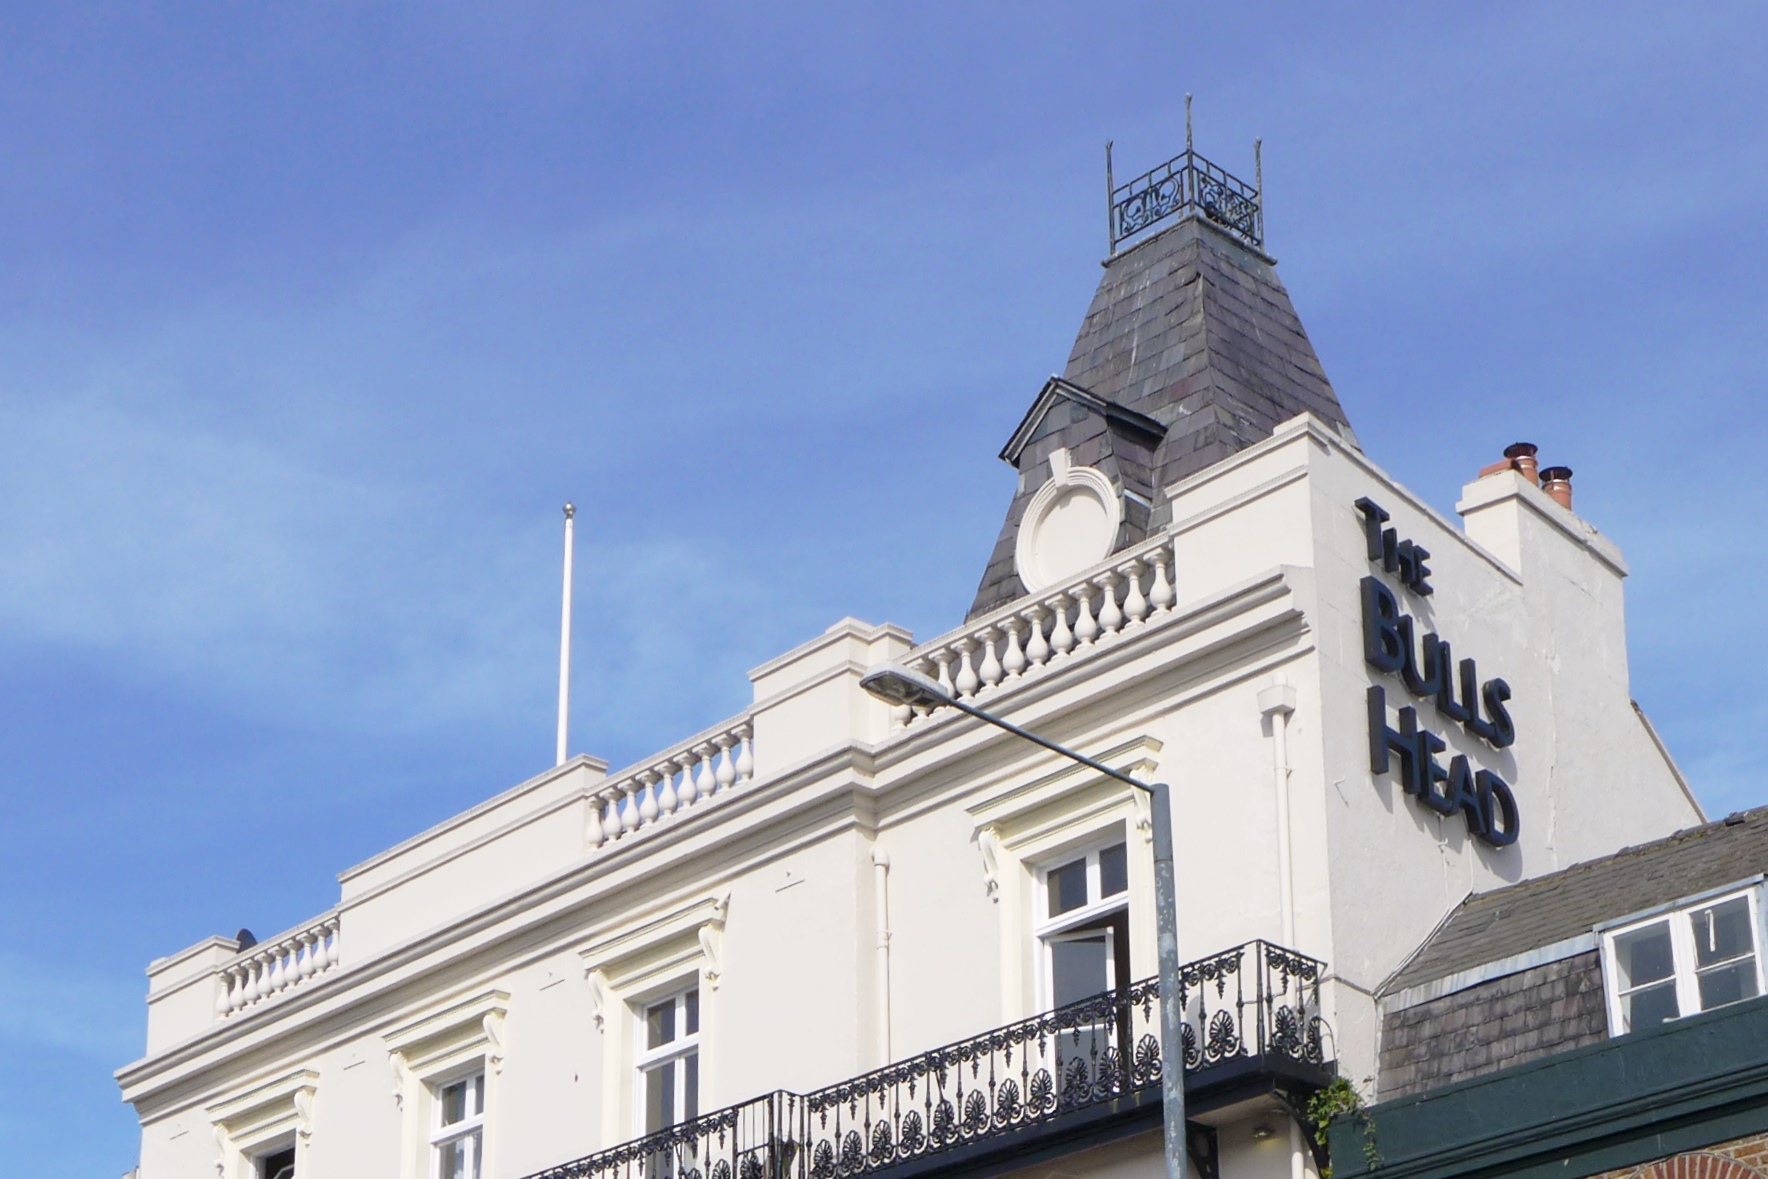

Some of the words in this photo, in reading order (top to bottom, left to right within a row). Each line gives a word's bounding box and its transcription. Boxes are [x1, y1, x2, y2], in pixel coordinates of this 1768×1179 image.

[1354, 496, 1434, 596] THE
[1360, 575, 1515, 749] BULLS
[1367, 684, 1520, 848] HEAD
